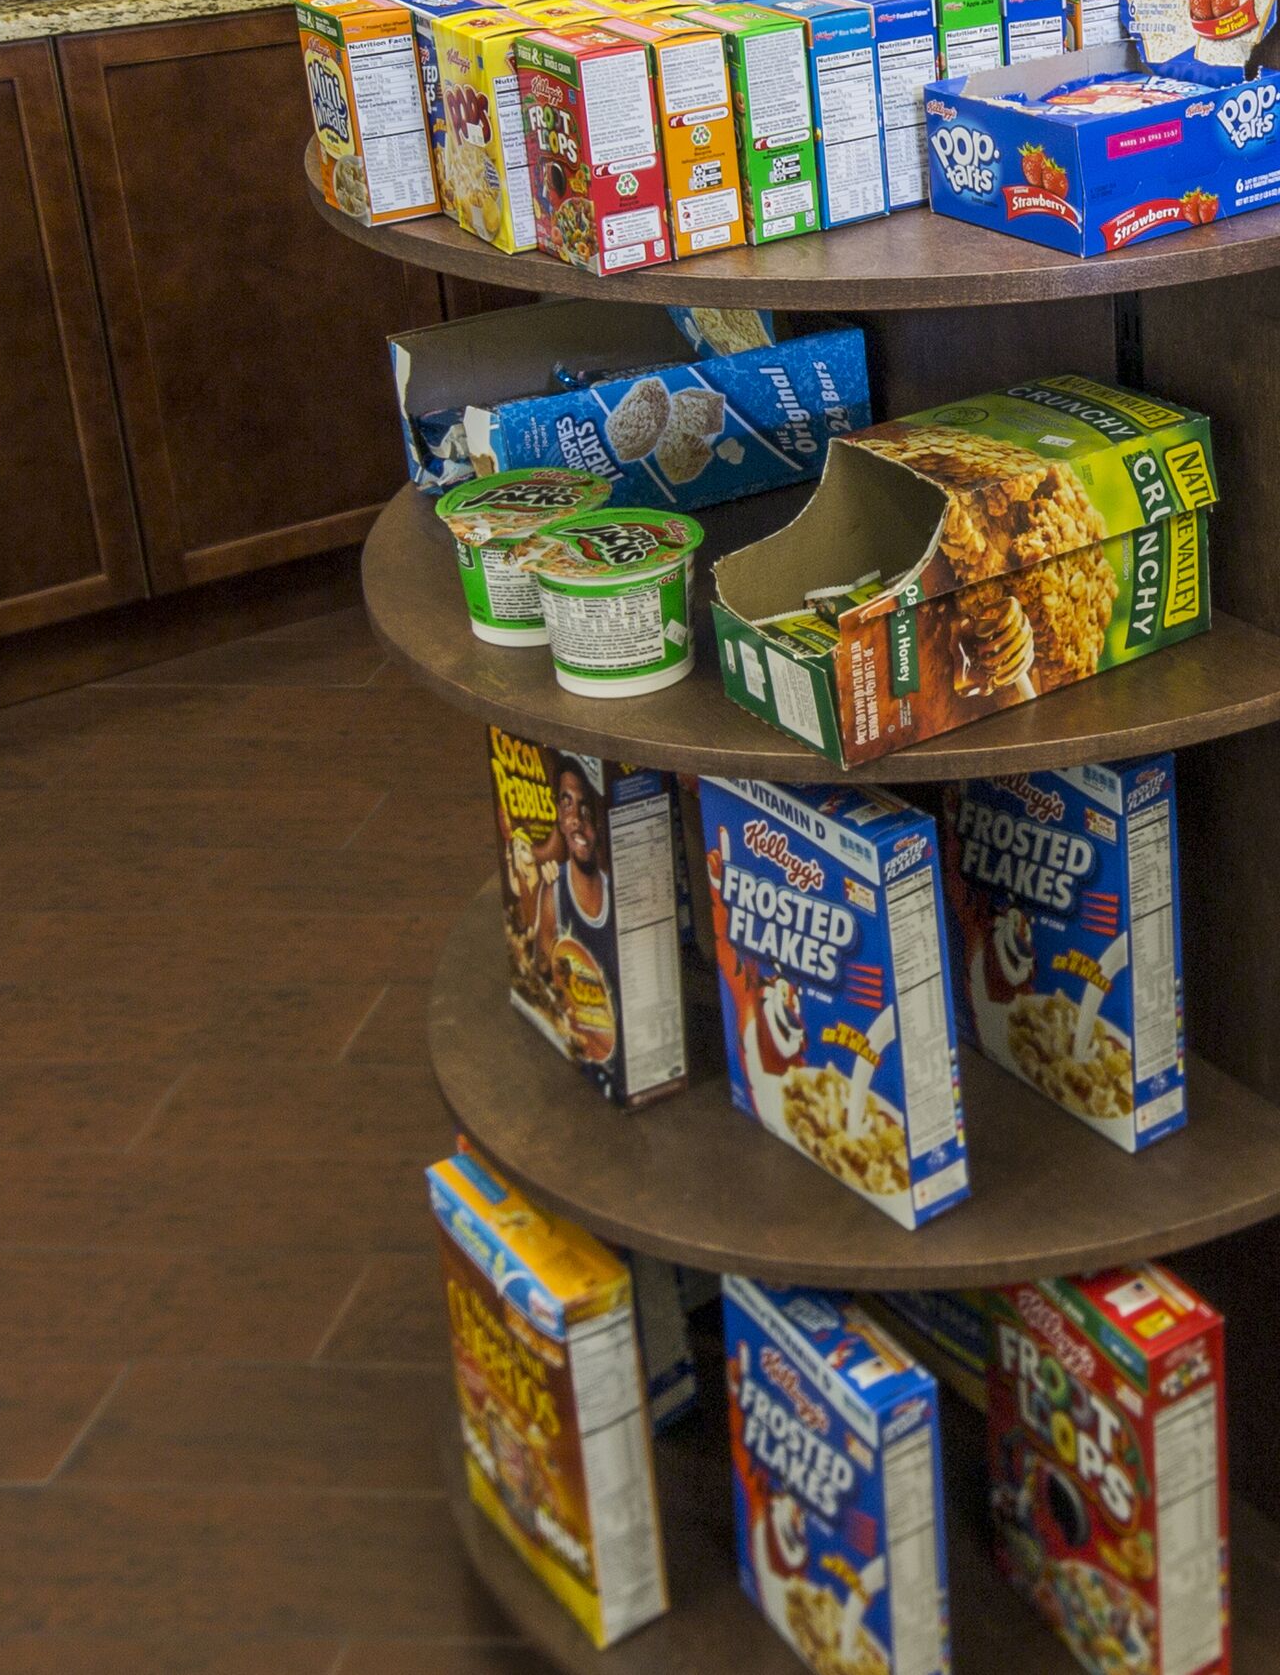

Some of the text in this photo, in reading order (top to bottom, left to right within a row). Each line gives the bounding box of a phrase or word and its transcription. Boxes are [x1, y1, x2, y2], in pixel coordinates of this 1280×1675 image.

[1010, 18, 1061, 30] Nutrition Facts
[1129, 2, 1136, 17] 6
[348, 36, 412, 50] Nutrition Facts
[879, 37, 933, 50] Nutrition Facts
[946, 25, 998, 39] Nutrition Facts
[818, 49, 871, 65] Nutrition Facts
[1231, 113, 1274, 149] tarts
[946, 164, 993, 193] tarts
[1235, 178, 1244, 194] 6
[1011, 193, 1067, 215] Strawberry
[1113, 206, 1180, 246] Strawberry
[812, 361, 840, 402] Bars
[758, 367, 818, 453] THE Original
[1007, 386, 1136, 438] CRUNCHY
[459, 488, 584, 511] JACKS
[1173, 540, 1198, 621] VALLEY
[896, 584, 919, 682] Oas 'n Honey
[489, 726, 547, 783] COCOA
[491, 758, 558, 823] PEBBLES
[1127, 771, 1166, 804] FROSTED
[1128, 785, 1162, 812] FLAKES
[749, 780, 826, 840] VITAMIN D
[743, 820, 825, 893] Kellogg's
[884, 836, 928, 874] FROSTED
[958, 801, 1093, 878] FROSTED
[885, 852, 922, 881] FLAKES
[961, 838, 1075, 910] FLAKES
[723, 866, 854, 948] FROSTED
[729, 905, 838, 982] FLAKES
[740, 1376, 855, 1492] FROSTED
[744, 1415, 838, 1516] FLAKES
